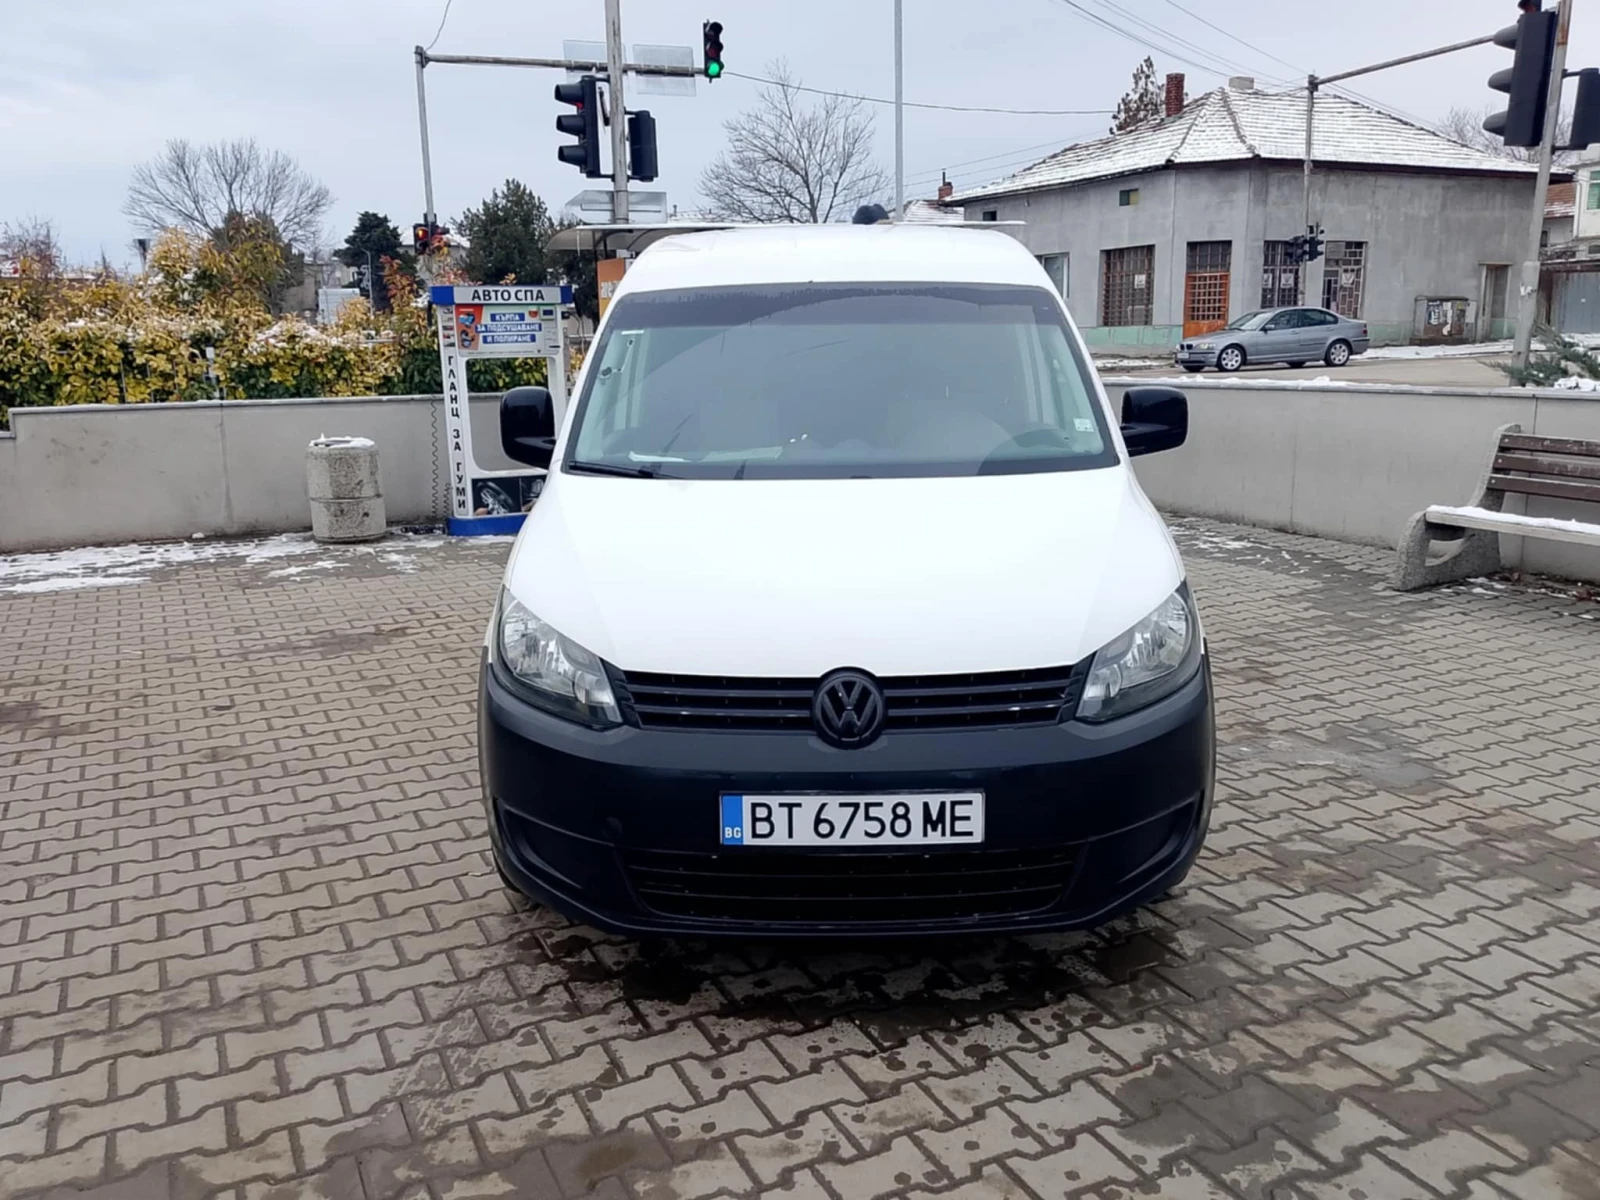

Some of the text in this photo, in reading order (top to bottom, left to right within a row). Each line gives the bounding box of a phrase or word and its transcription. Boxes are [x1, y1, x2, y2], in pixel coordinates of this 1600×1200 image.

[471, 289, 545, 301] АВТО СПА
[495, 313, 520, 321] КЪРПА
[476, 323, 540, 332] ЗА ПОДСУШАВАНЕ
[494, 334, 532, 342] ПОЛИРАНЕ
[447, 356, 466, 509] ГЛАНЦ ЗА ГУМИ
[750, 800, 974, 839] BT 6758 ME
[724, 827, 742, 839] BG
